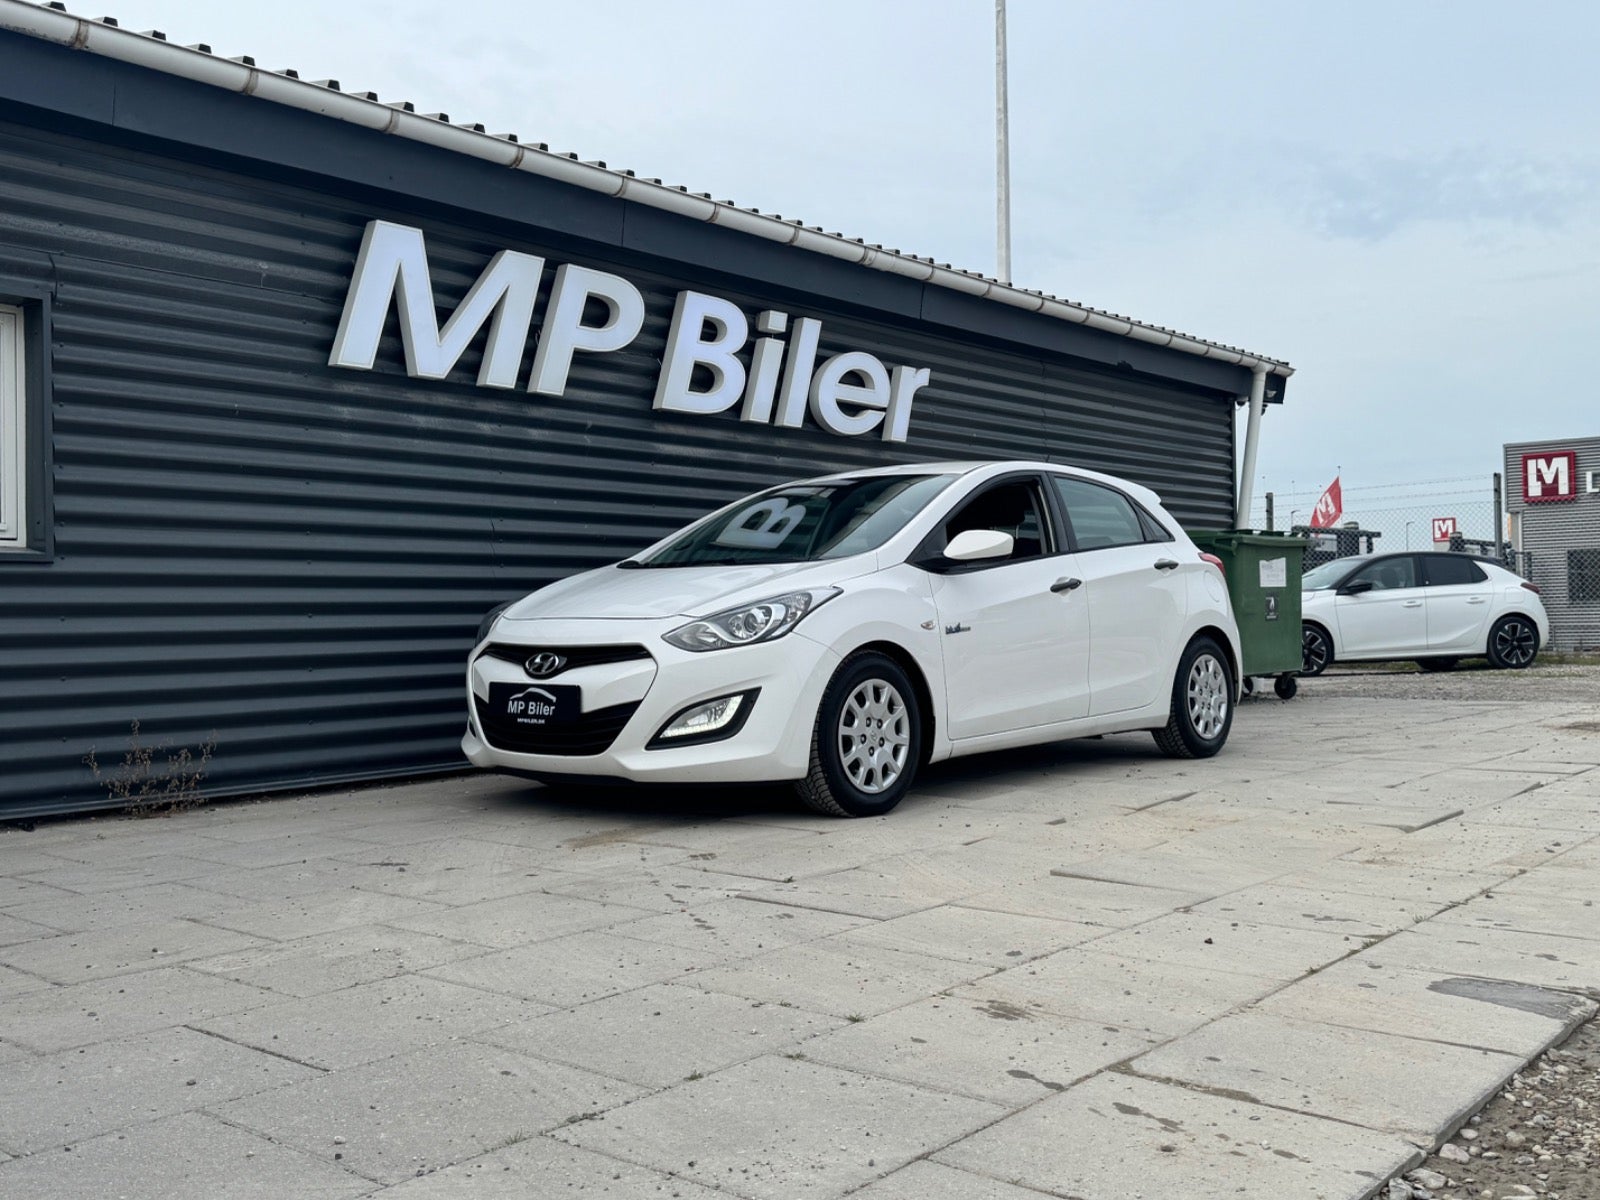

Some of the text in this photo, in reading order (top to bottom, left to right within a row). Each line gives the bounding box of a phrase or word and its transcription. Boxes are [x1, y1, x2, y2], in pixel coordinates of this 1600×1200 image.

[328, 219, 930, 442] MP Biler
[507, 700, 556, 716] MP Biler
